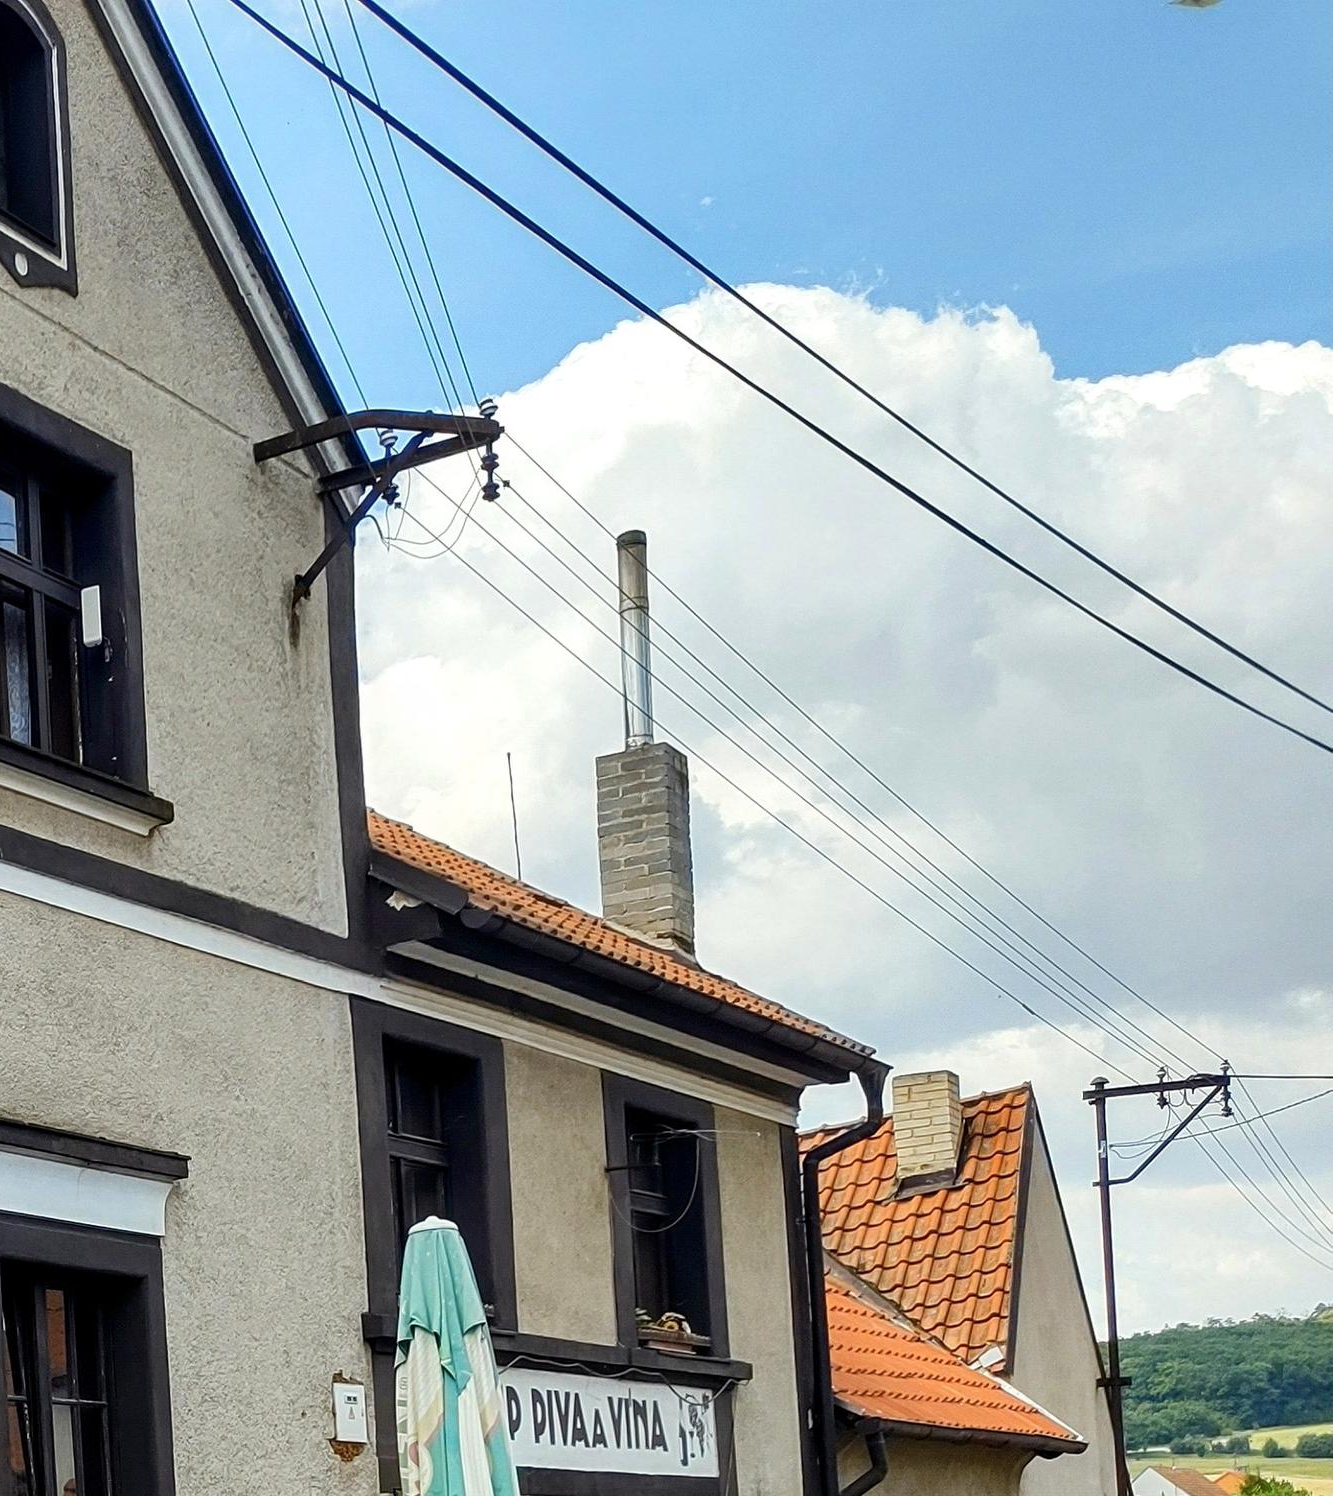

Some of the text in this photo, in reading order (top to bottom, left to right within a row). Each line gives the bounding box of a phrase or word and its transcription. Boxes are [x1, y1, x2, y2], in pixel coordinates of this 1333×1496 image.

[502, 1384, 522, 1441] P
[530, 1387, 591, 1448] PIVA
[592, 1407, 608, 1448] A
